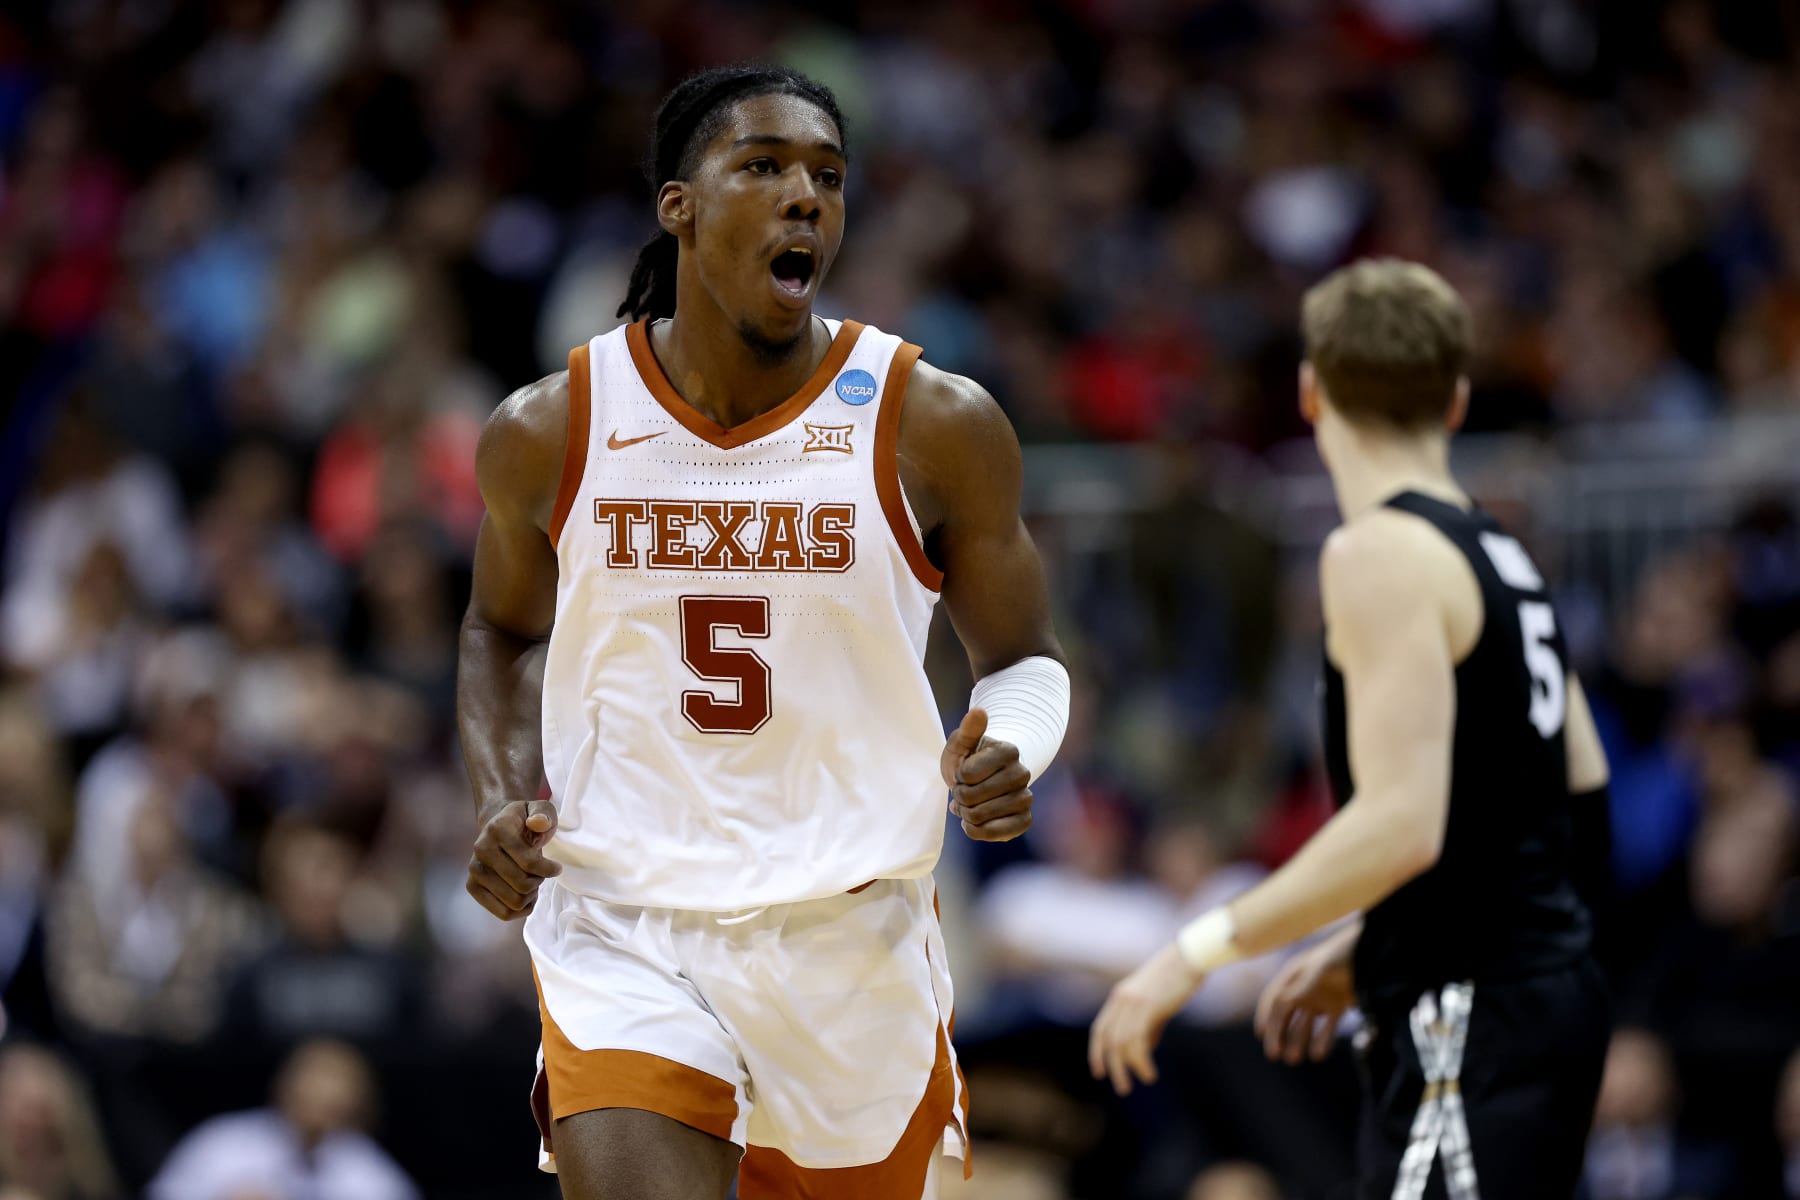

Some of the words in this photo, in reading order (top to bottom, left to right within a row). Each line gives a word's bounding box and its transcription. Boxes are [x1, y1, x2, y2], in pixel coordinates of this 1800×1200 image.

[841, 384, 874, 398] NCAA
[594, 499, 856, 573] TEXAS
[679, 595, 772, 734] 5
[1518, 601, 1565, 738] 5
